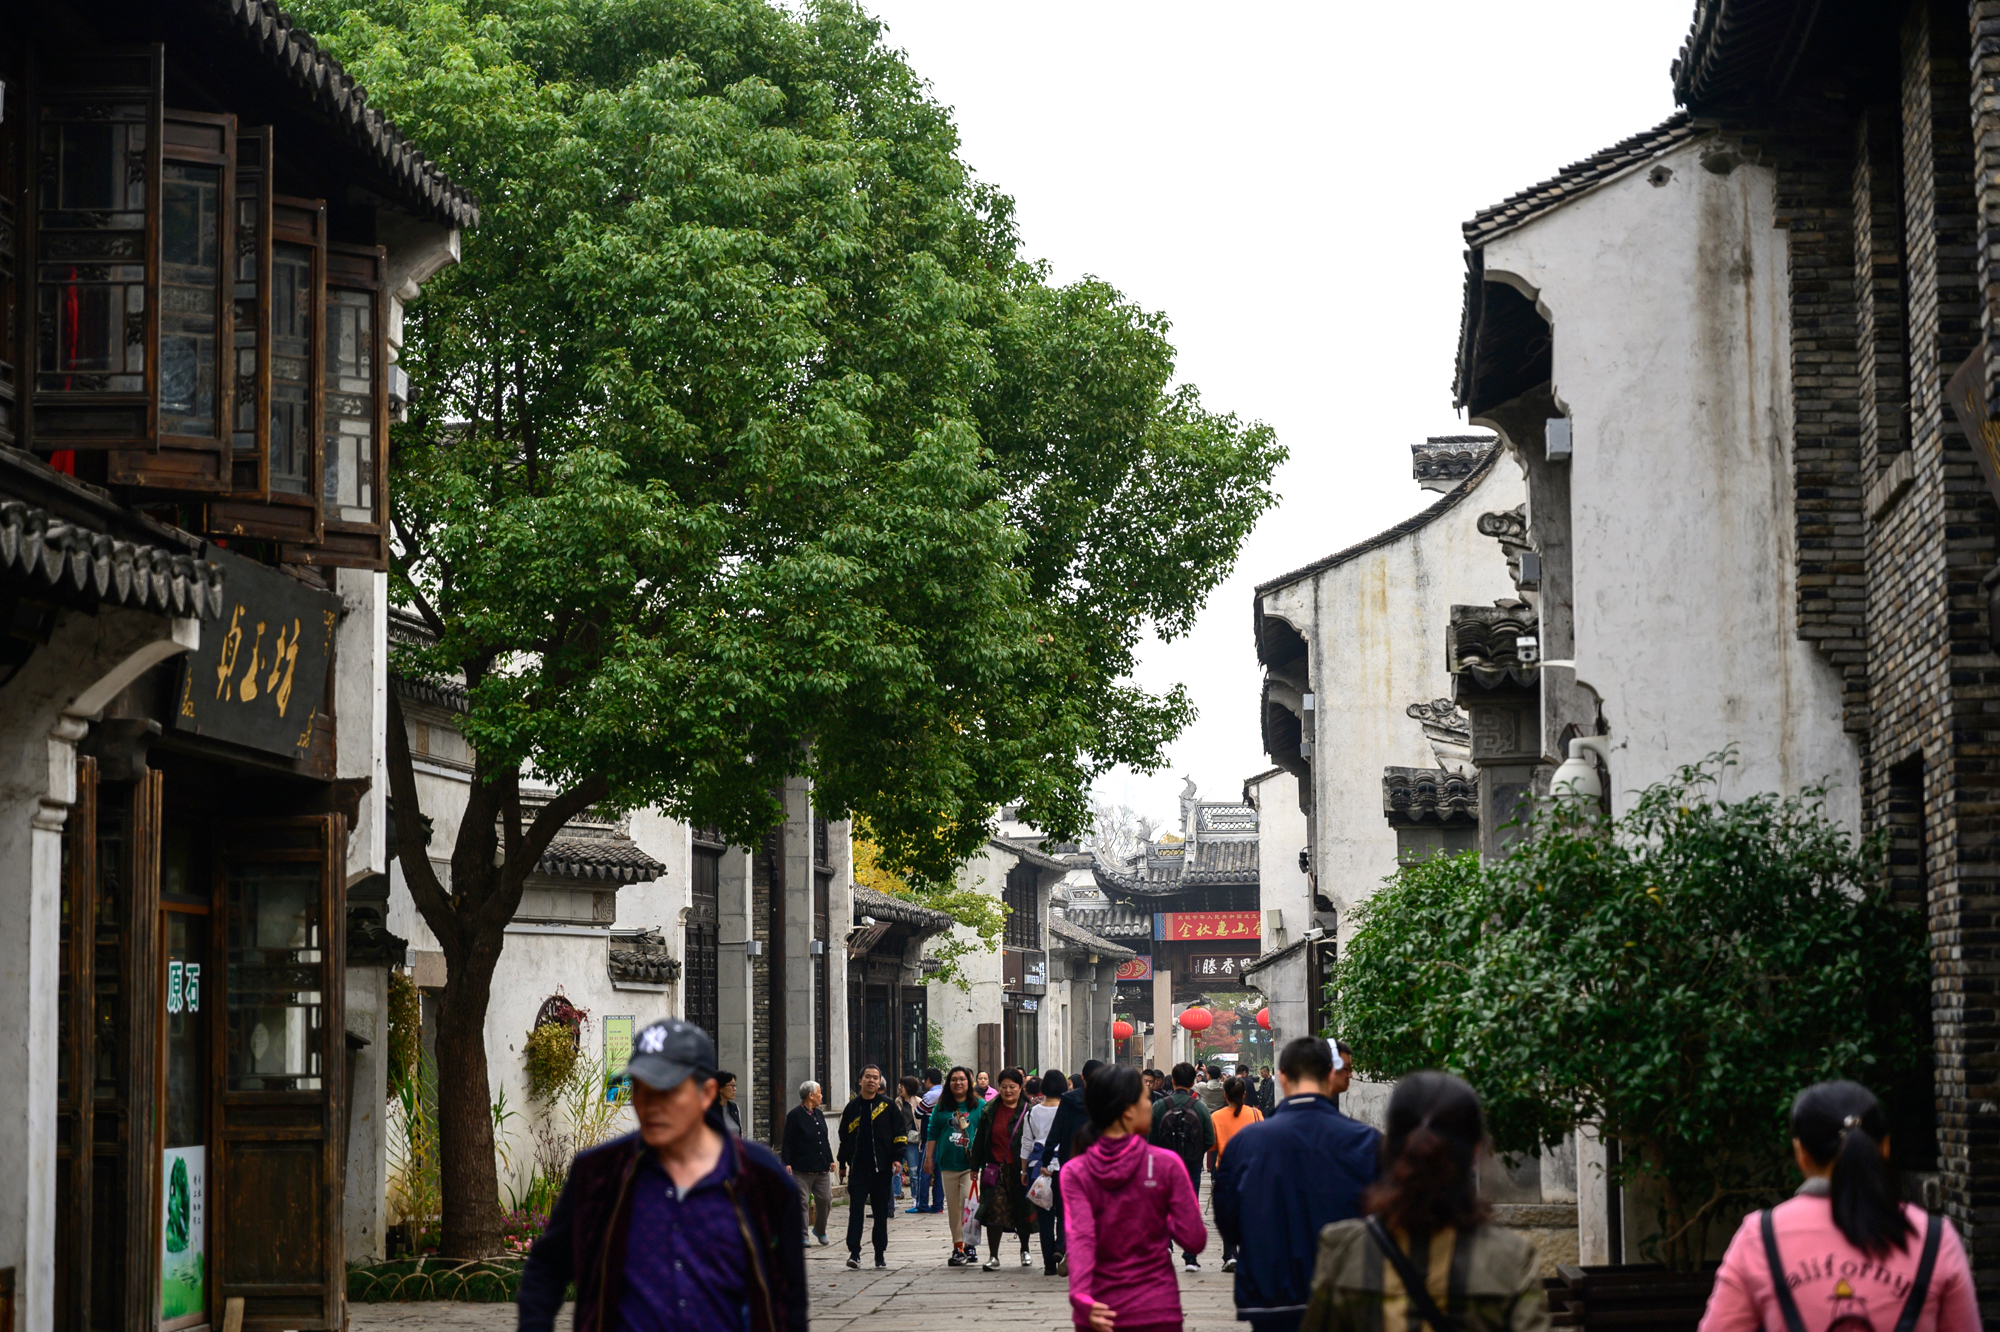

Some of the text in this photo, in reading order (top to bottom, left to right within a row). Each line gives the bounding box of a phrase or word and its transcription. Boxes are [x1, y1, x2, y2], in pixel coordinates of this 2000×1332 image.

[1177, 913, 1261, 921] 庆祝中华人民共和国成立
[167, 961, 200, 1013] 原石
